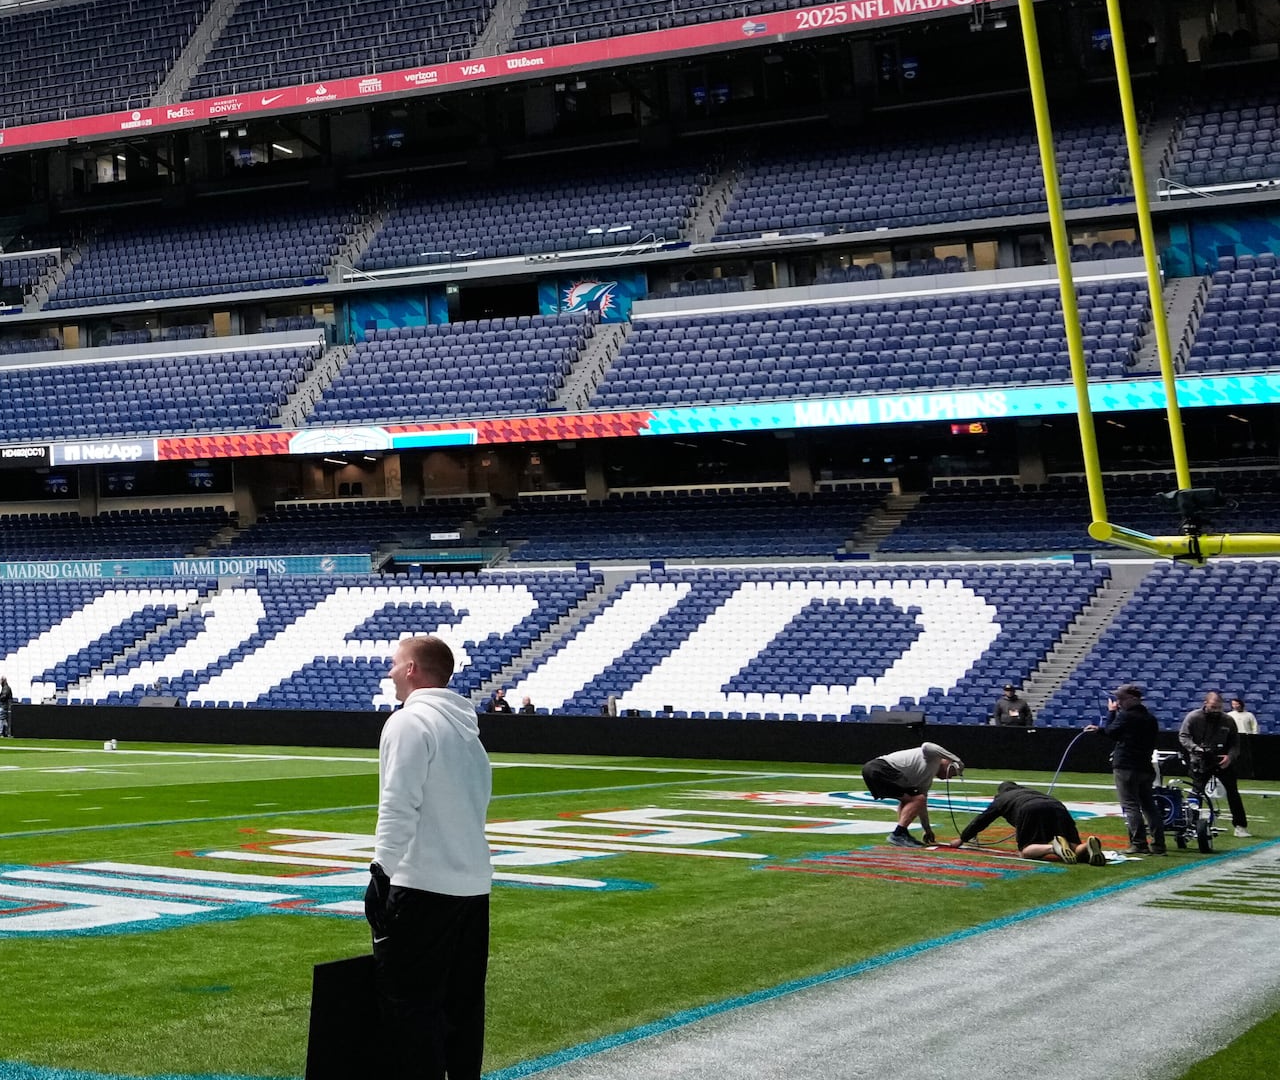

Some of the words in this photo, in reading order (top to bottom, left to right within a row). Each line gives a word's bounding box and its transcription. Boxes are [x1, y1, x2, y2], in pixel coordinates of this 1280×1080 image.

[796, 5, 848, 30] 2025
[851, 0, 890, 21] NFL
[460, 64, 486, 76] VISA
[506, 57, 544, 69] Wilson
[405, 70, 437, 82] verizon
[306, 94, 337, 104] Santander
[167, 107, 195, 119] FedEx
[794, 399, 869, 426] MIAMI
[878, 390, 1007, 422] DOLPHINS
[82, 443, 143, 460] NetApp
[6, 563, 59, 580] MADRID
[61, 562, 102, 578] GAME
[173, 561, 215, 576] MIAMI
[219, 559, 286, 575] DOLPHINS
